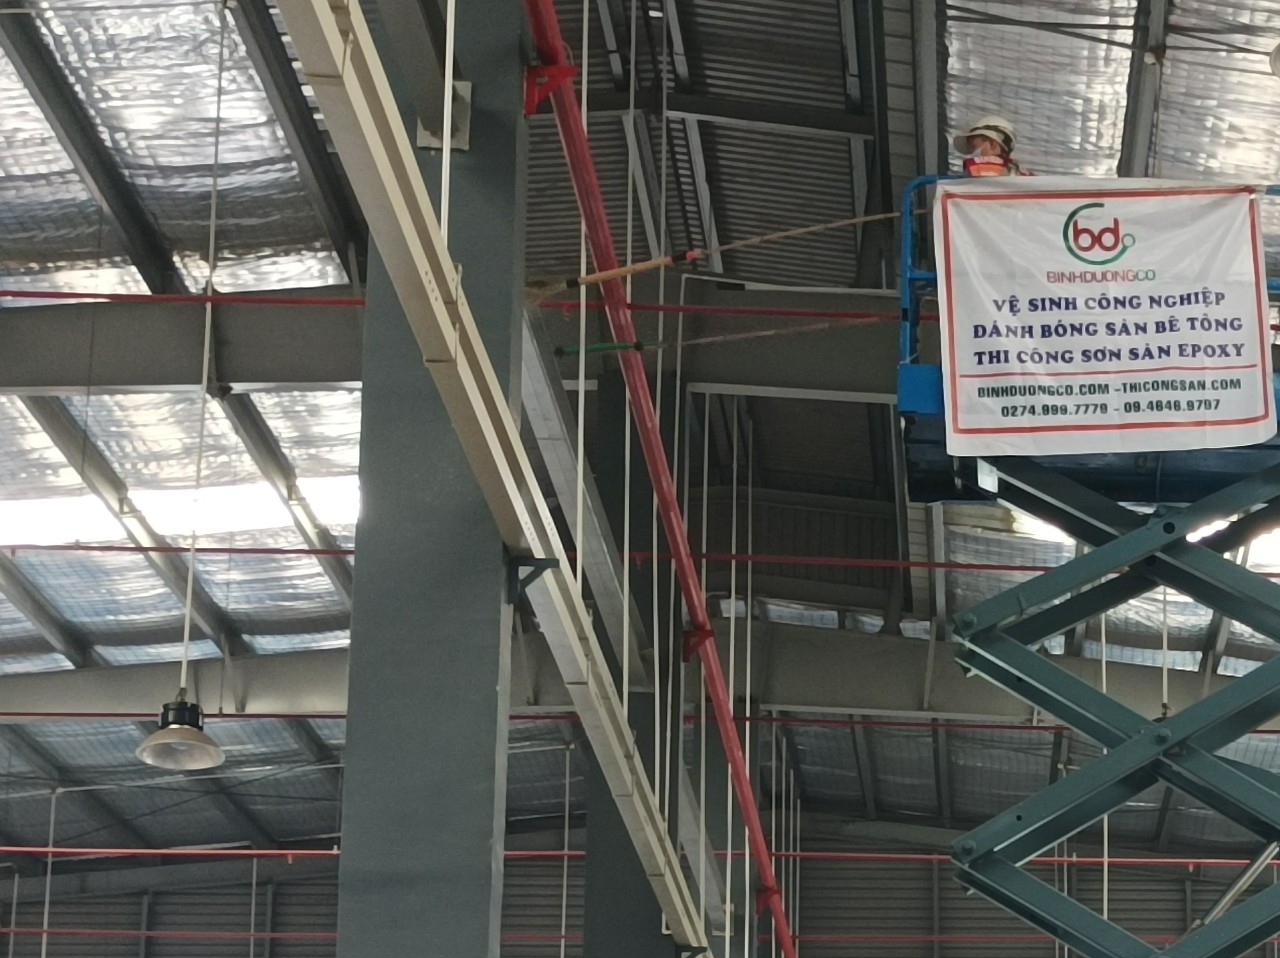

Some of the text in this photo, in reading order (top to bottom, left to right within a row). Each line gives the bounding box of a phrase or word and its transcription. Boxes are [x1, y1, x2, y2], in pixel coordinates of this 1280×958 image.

[1047, 269, 1156, 284] BINHDUONGCO
[992, 287, 1226, 317] VỆ SINH CÔNG NGHIỆP
[1040, 319, 1099, 339] BÓNG
[1154, 315, 1181, 334] BÊ
[1186, 313, 1244, 332] TÔNG
[974, 350, 1010, 365] THI
[1016, 348, 1075, 365] CÔNG
[1081, 346, 1122, 363] SƠN
[1178, 343, 1245, 358] EPOXY
[978, 383, 1110, 398] BINHDUONGCO.COM
